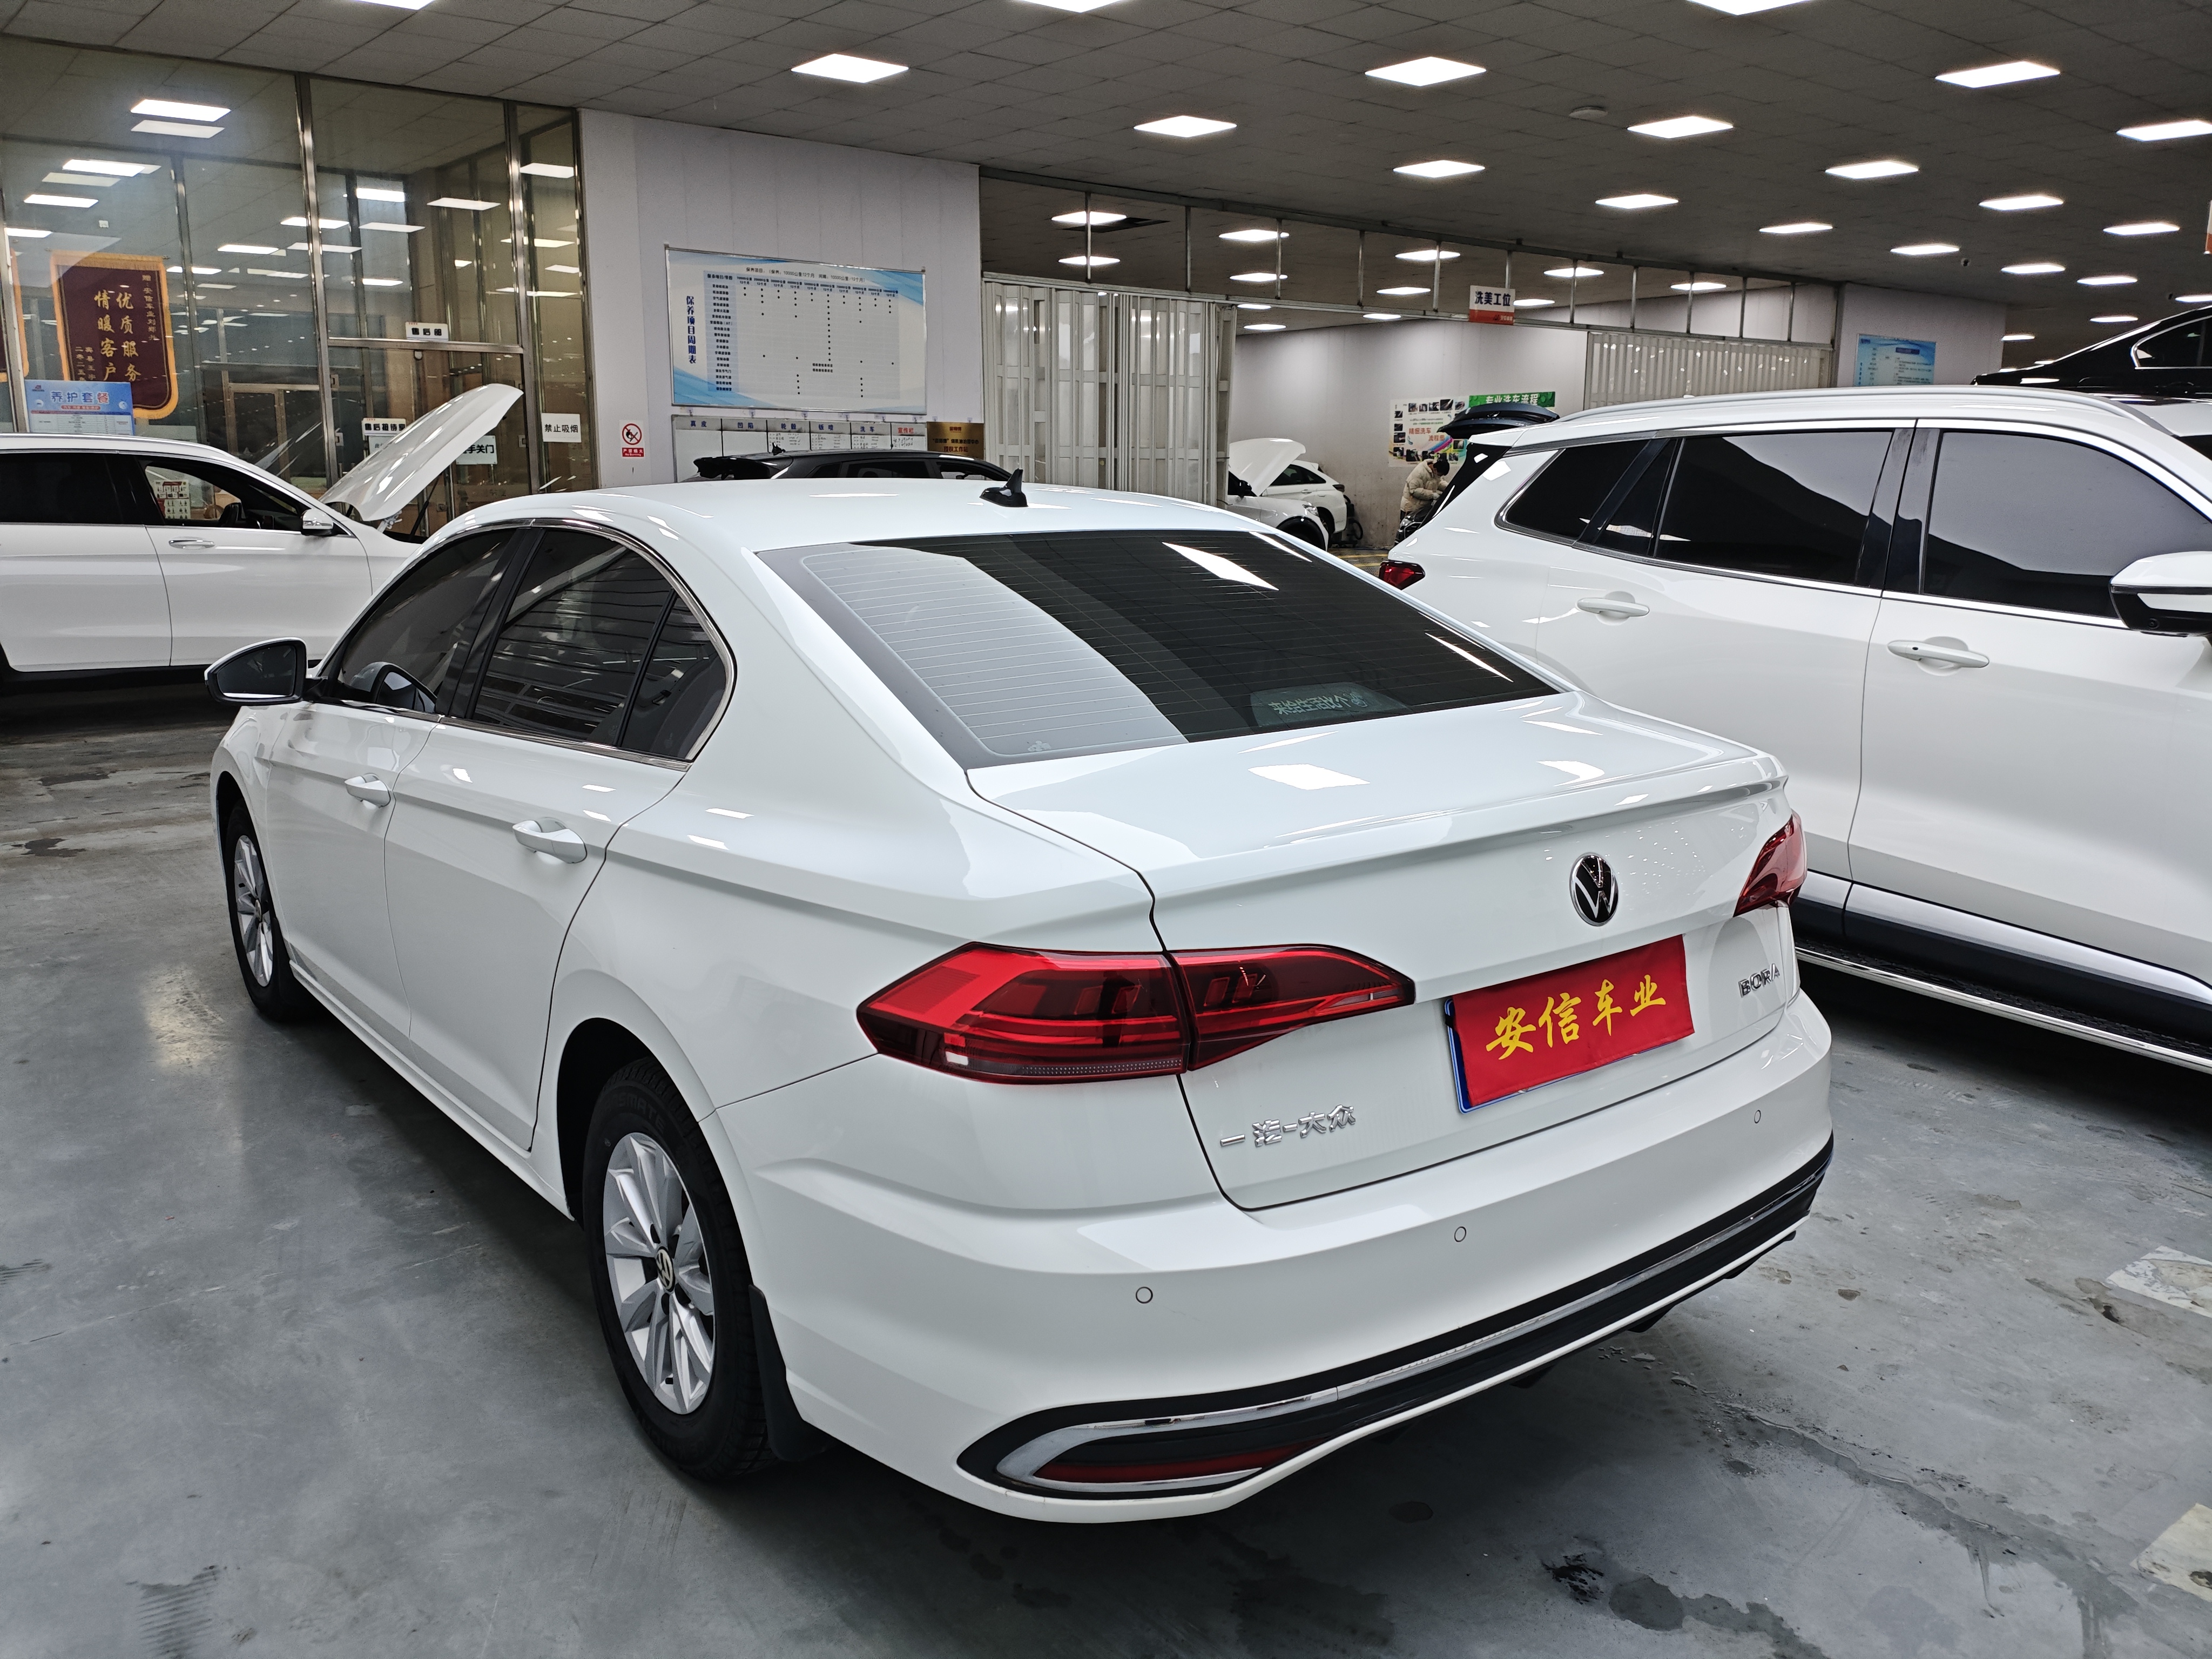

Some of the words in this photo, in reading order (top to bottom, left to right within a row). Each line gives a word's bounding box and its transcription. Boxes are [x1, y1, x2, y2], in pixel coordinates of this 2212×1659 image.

[1475, 291, 1511, 306] 洗美工位
[94, 289, 117, 381] 情暖客户
[116, 292, 141, 381] 优质服务
[686, 296, 696, 363] 保养项目周期表
[51, 392, 109, 403] 养护套餐
[544, 424, 578, 433] 禁止吸烟
[463, 444, 495, 454] 手关门
[1738, 963, 1780, 998] BORA
[1486, 974, 1666, 1061] 安信车业
